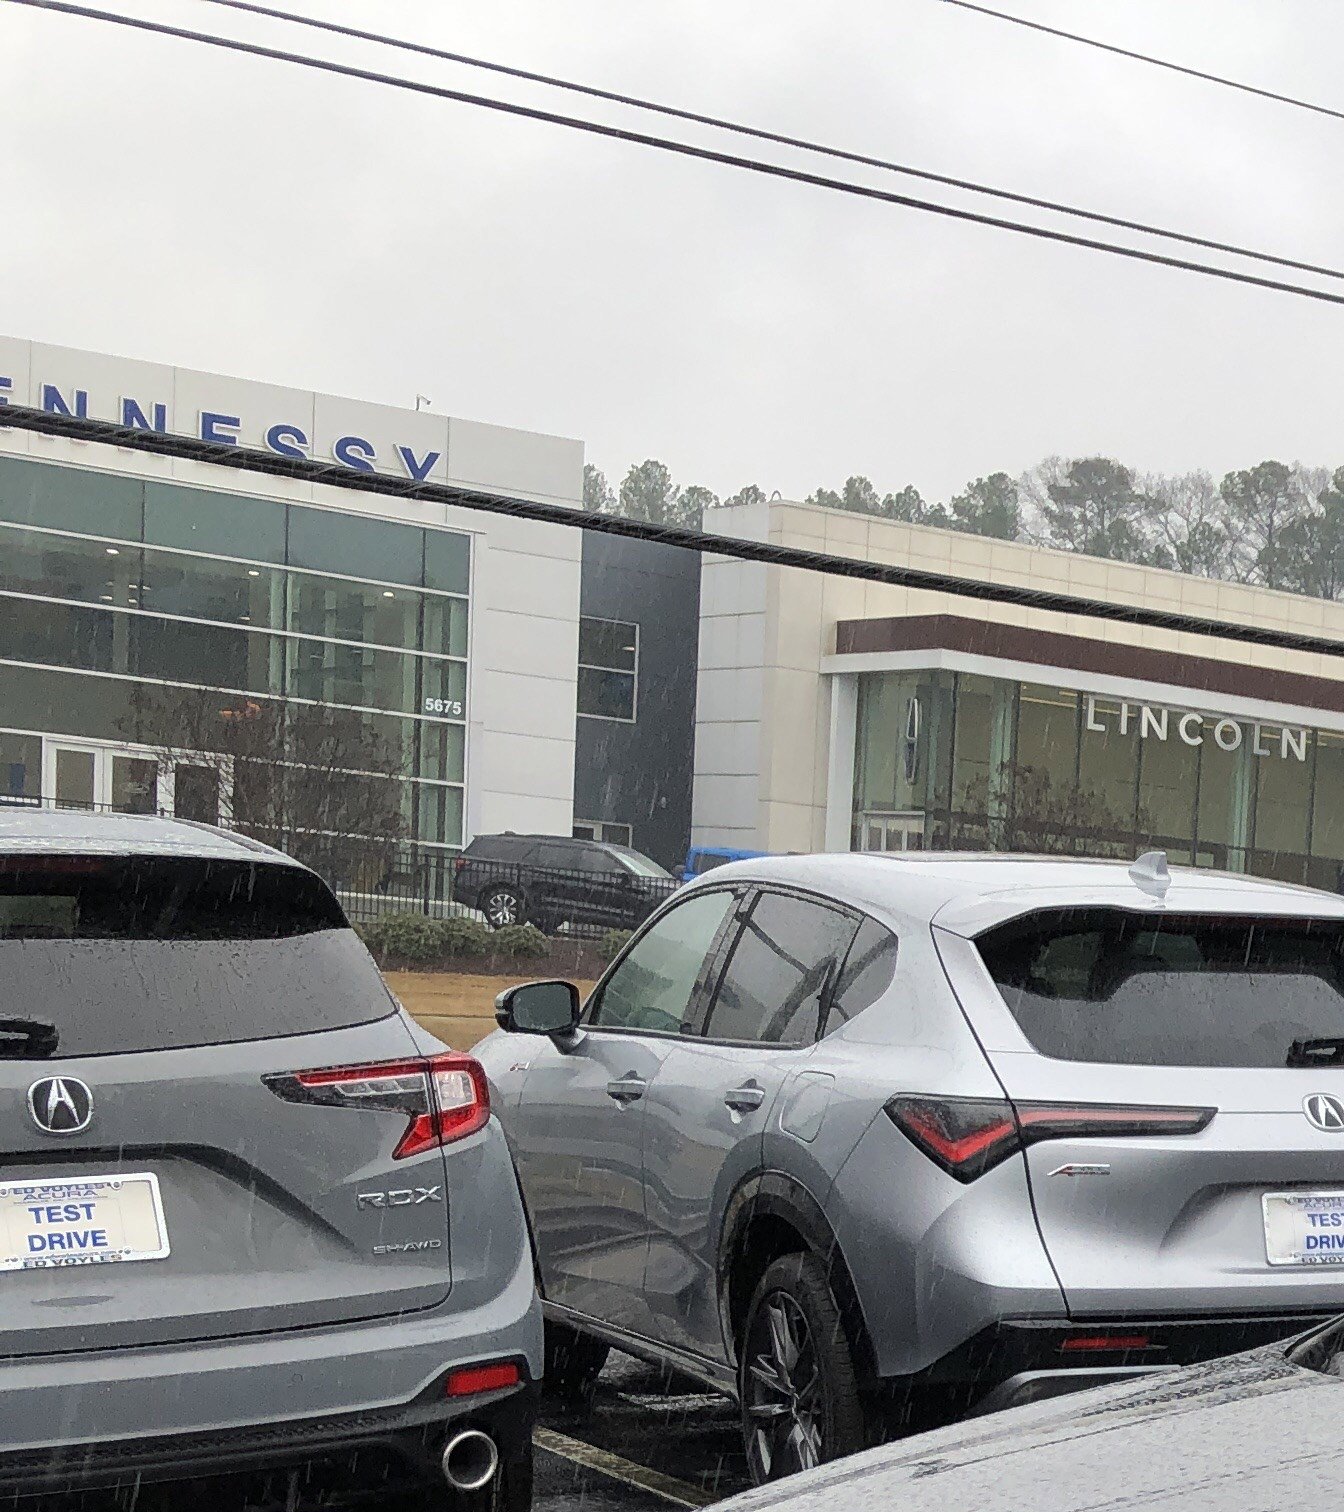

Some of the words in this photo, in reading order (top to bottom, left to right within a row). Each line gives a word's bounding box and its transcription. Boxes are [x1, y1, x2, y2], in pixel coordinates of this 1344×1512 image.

[0, 376, 441, 483] NNESSY
[425, 697, 462, 715] 5675
[1086, 694, 1307, 762] LINCOLN
[23, 1190, 98, 1201] ACURA
[357, 1185, 442, 1211] RDX
[28, 1203, 96, 1224] TEST
[28, 1229, 109, 1252] DRIVE
